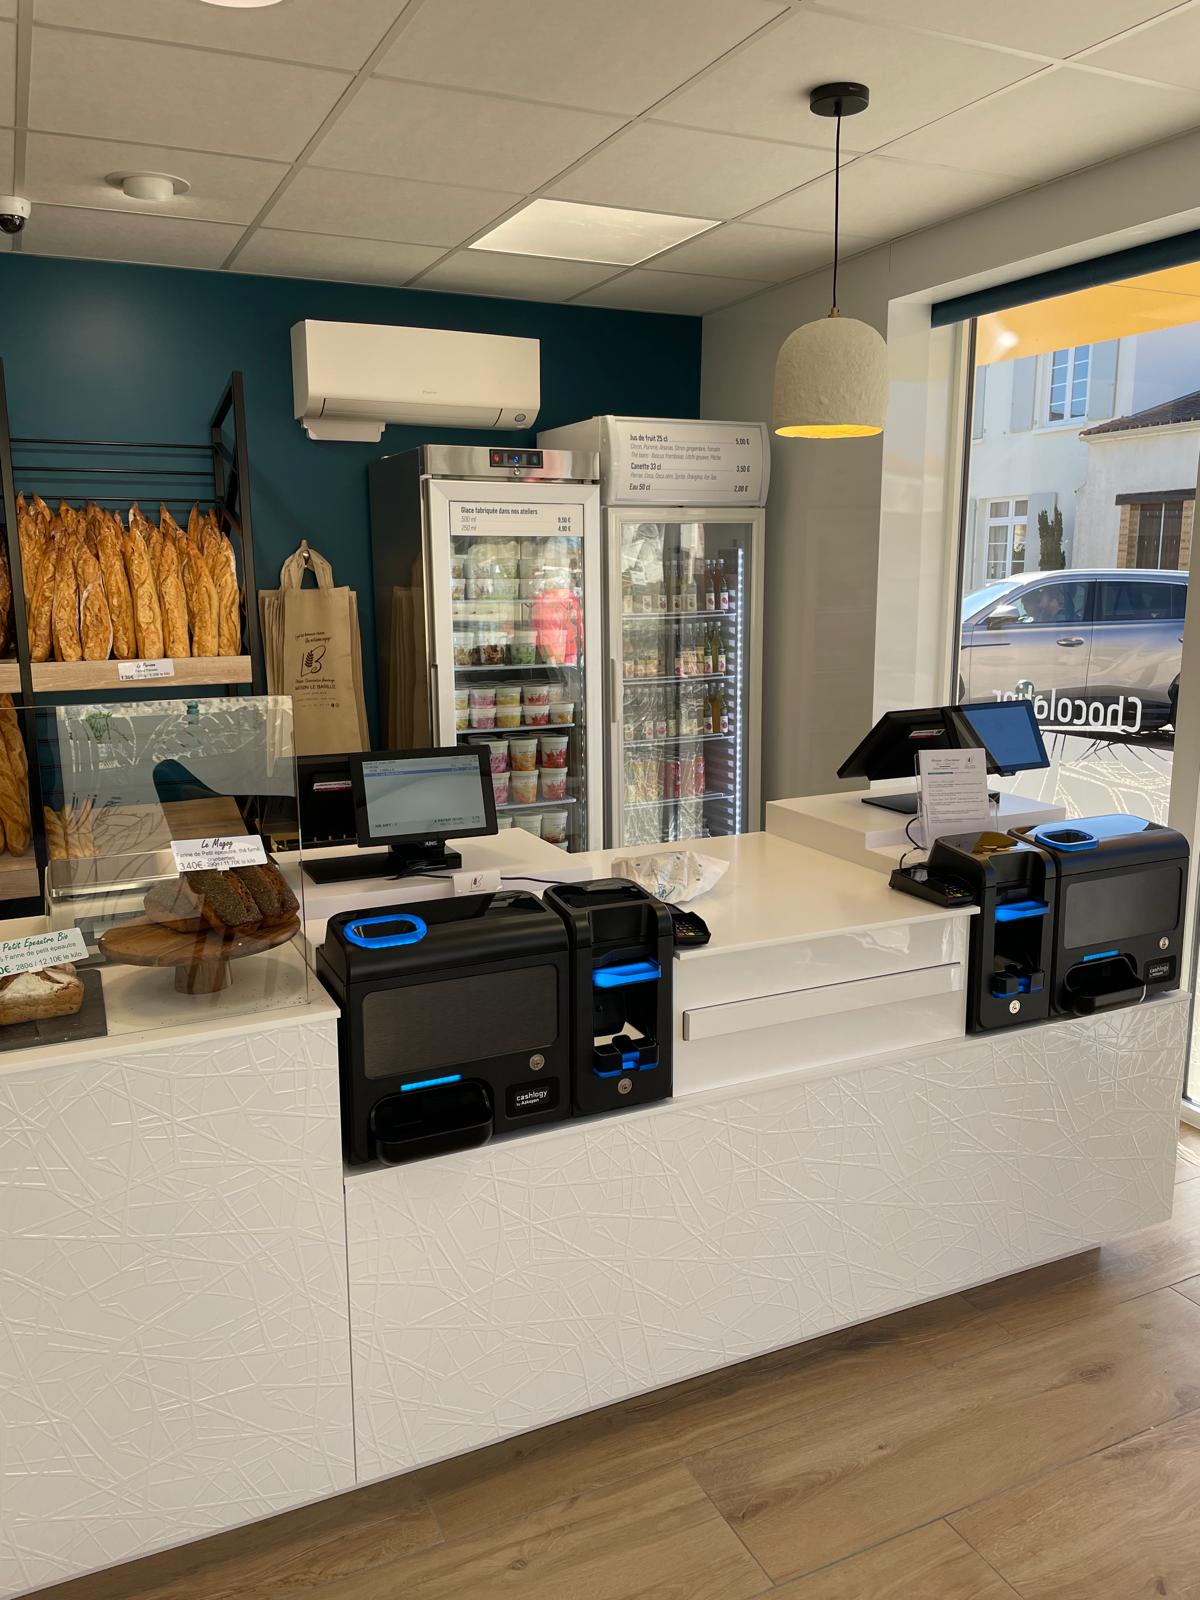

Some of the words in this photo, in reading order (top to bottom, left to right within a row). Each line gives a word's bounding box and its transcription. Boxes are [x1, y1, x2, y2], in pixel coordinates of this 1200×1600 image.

[645, 434, 656, 442] fruit
[630, 462, 650, 470] Canette
[460, 506, 475, 514] Glace
[520, 508, 538, 516] ateliers
[201, 840, 209, 849] Le
[57, 931, 69, 942] Bio
[35, 947, 50, 955] petit
[516, 1090, 548, 1102] cashlogy
